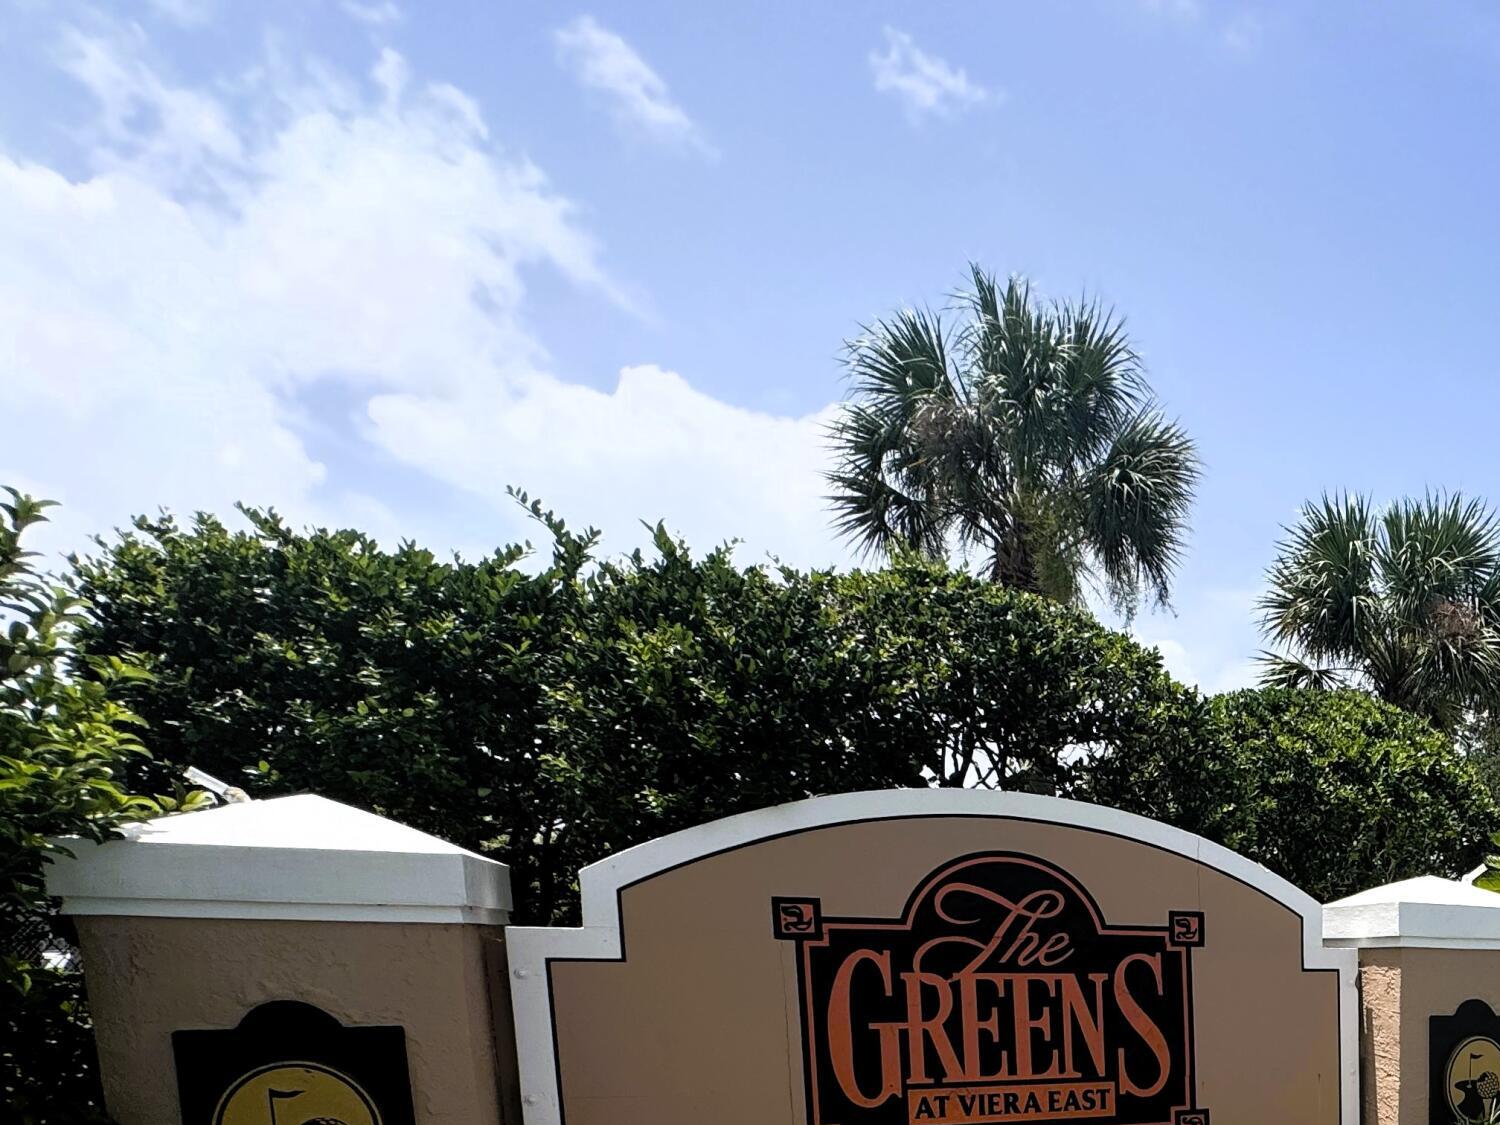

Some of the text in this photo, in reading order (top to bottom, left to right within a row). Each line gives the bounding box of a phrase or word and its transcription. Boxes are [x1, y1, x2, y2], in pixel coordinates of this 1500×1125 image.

[913, 882, 1074, 982] The
[828, 949, 1171, 1109] GREENS
[915, 1088, 1110, 1120] AT VIERA EAST
